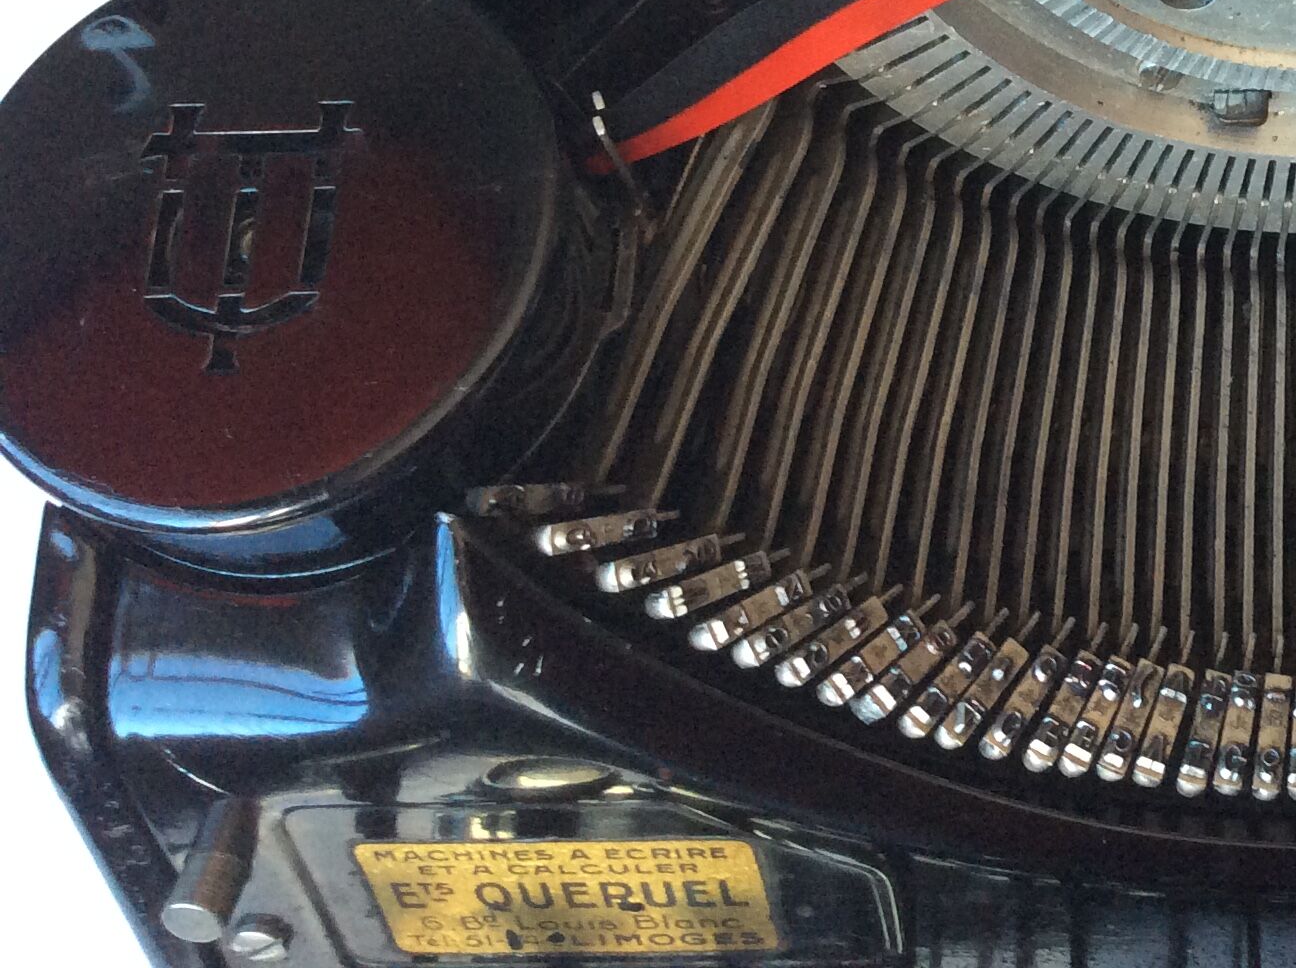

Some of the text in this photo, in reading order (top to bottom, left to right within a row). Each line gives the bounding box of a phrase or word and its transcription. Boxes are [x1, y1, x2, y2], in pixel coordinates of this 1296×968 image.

[374, 850, 554, 862] MACHINES
[604, 847, 728, 860] ECRIRE
[418, 865, 456, 876] ET
[508, 863, 698, 875] CALCULER
[634, 913, 745, 930] Blanc
[571, 932, 766, 946] LIMOGES
